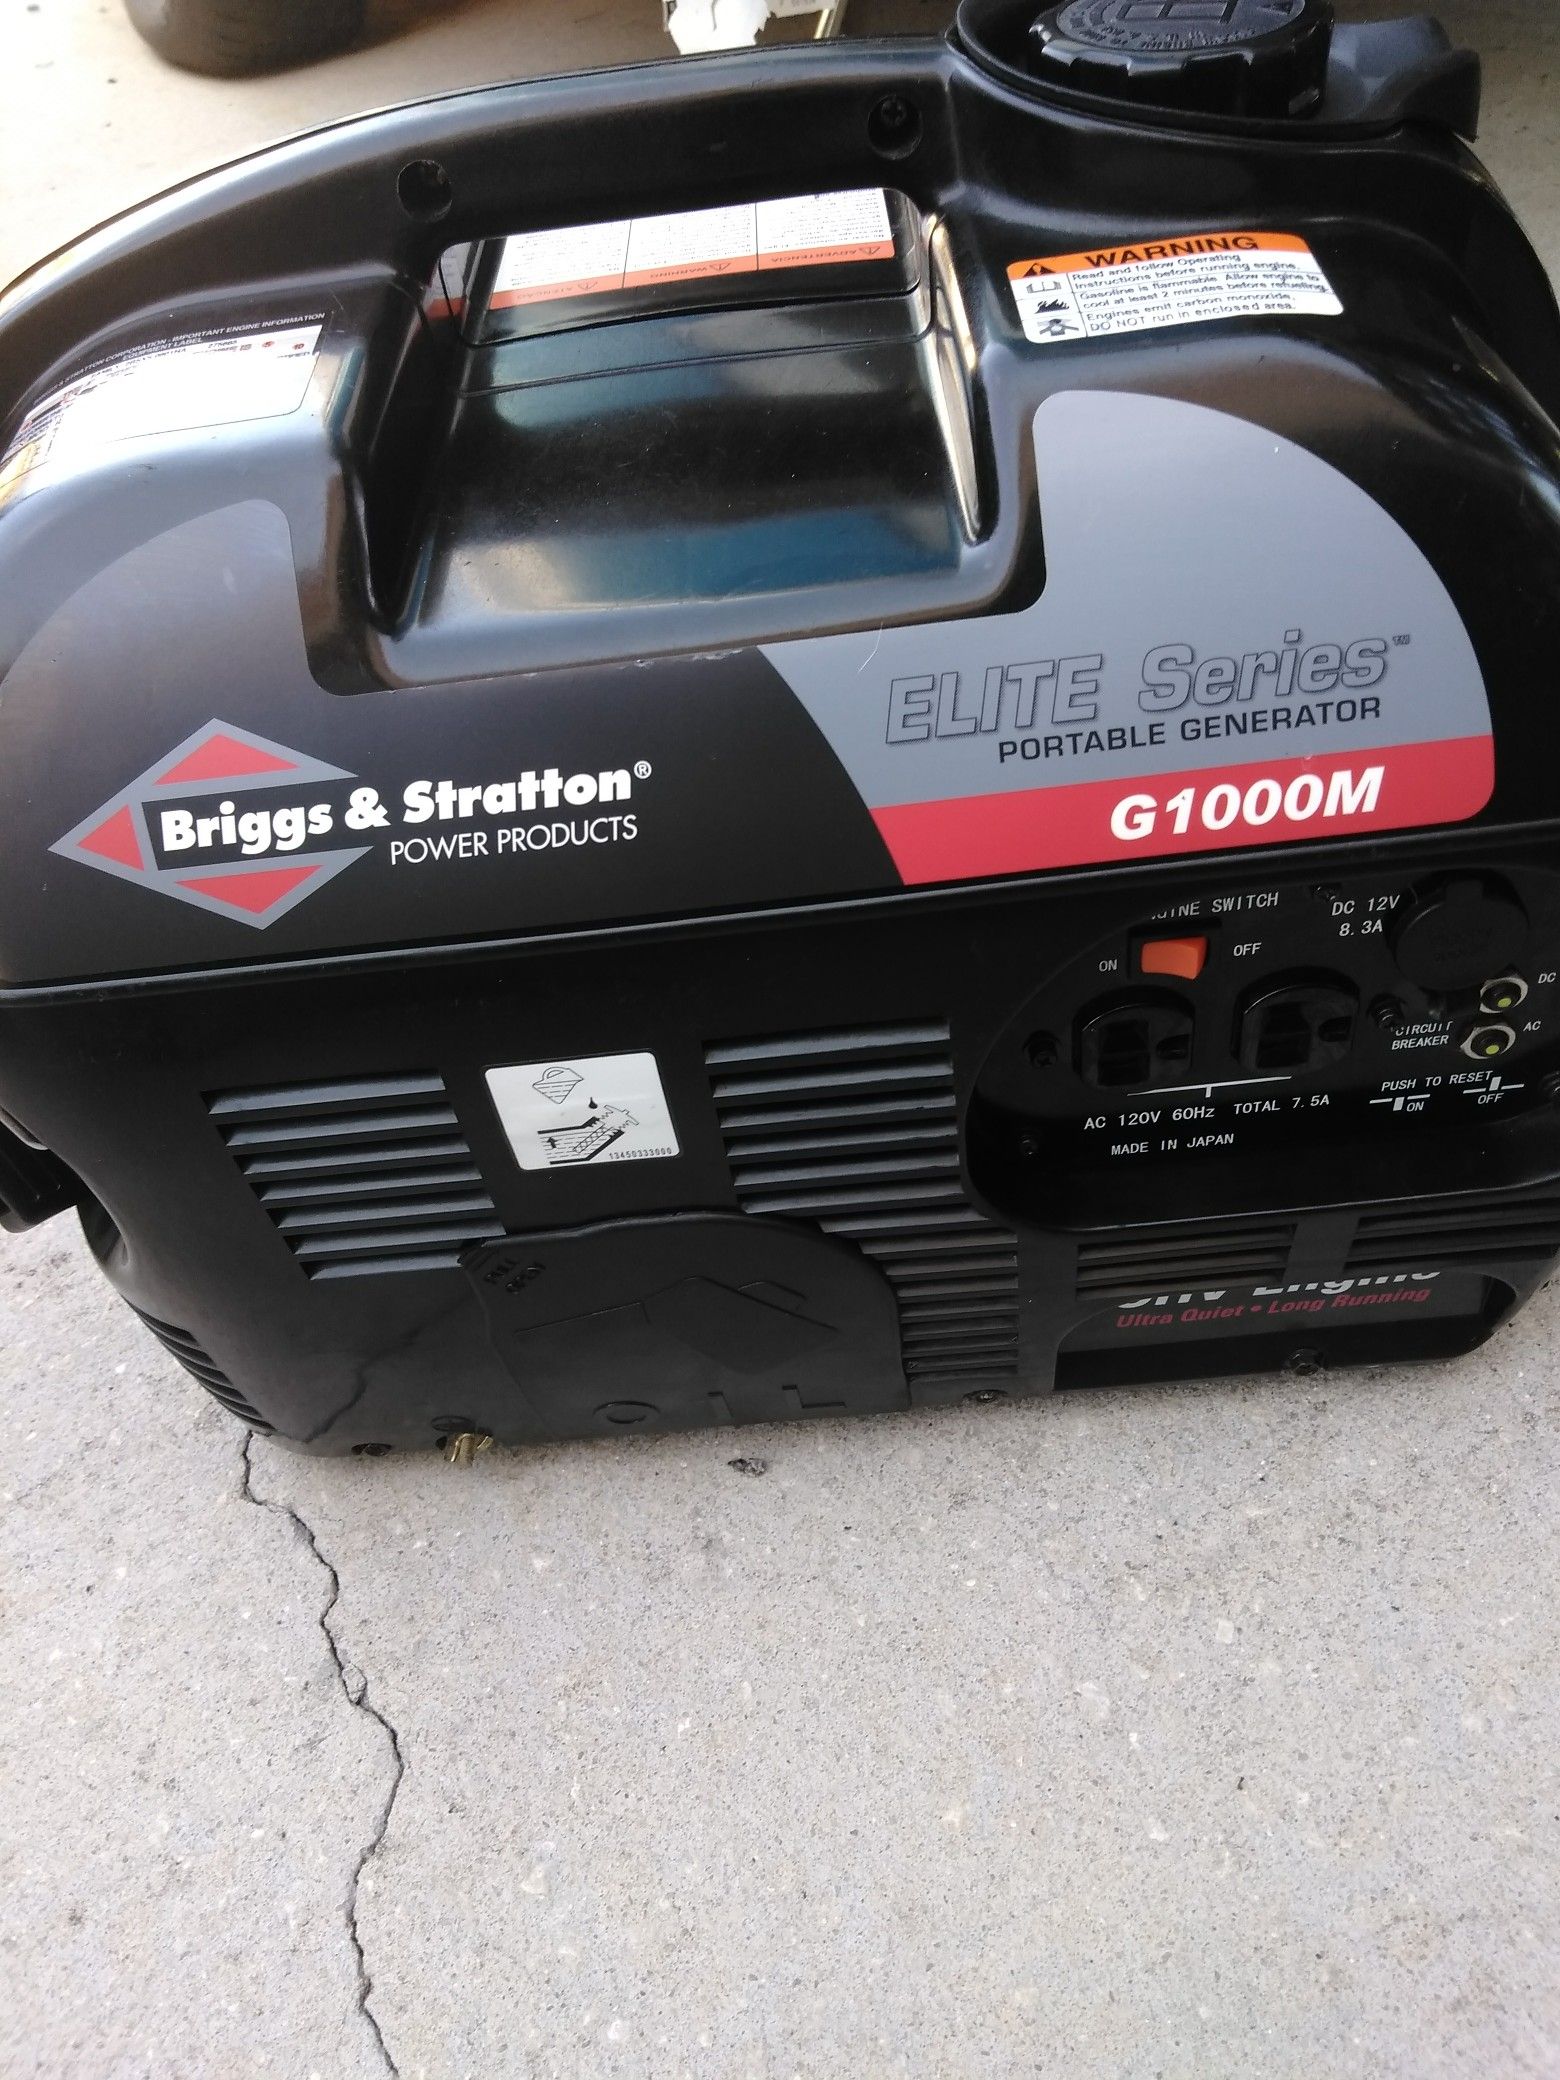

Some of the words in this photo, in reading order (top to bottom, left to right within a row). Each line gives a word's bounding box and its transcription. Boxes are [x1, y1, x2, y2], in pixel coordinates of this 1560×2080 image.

[1084, 236, 1259, 268] WARNING
[1072, 271, 1104, 281] Read
[1109, 266, 1131, 275] and
[1135, 261, 1174, 272] follow
[1177, 254, 1241, 267] Operating
[1074, 273, 1151, 290] Instructions
[1155, 267, 1196, 279] before
[1200, 261, 1250, 272] running
[1079, 288, 1134, 300] Gasoline
[1138, 285, 1149, 293] is
[1225, 273, 1258, 281] Allow
[1262, 272, 1304, 284] engine
[1306, 273, 1320, 282] to
[1083, 298, 1110, 309] cool
[1114, 296, 1125, 305] at
[1128, 292, 1159, 303] least
[1161, 290, 1169, 298] 2
[1173, 285, 1224, 298] minutes
[1227, 281, 1267, 290] before
[1086, 308, 1140, 321] Engines
[1144, 302, 1172, 312] emit
[1176, 297, 1222, 308] carbon
[1090, 321, 1111, 332] DO
[1116, 316, 1145, 328] NOT
[1152, 314, 1174, 323] run
[1178, 310, 1190, 319] in
[1194, 302, 1260, 316] enclosed
[105, 338, 167, 362] CORPORATION
[172, 327, 226, 342] IMPORTANT
[225, 322, 261, 333] ENGINE
[261, 312, 326, 328] INFORMATION
[122, 343, 172, 361] EQUIPMENT
[173, 337, 203, 347] LABEL
[885, 653, 1104, 745] ELITE
[998, 722, 1166, 764] PORTABLE
[1180, 696, 1382, 742] GENERATOR
[1109, 765, 1386, 843] G1000M
[159, 800, 334, 856] Briggs
[344, 785, 392, 831] &
[390, 830, 489, 867] POWER
[497, 813, 639, 855] PRODUCTS
[1151, 900, 1200, 920] INE
[1211, 891, 1280, 914] SWITCH
[1331, 900, 1356, 917] DC
[1366, 895, 1401, 913] 12V
[1233, 941, 1262, 957] OFF
[1098, 959, 1118, 973] ON
[1538, 972, 1557, 985] DC
[1522, 1020, 1542, 1033] AC
[1391, 1034, 1449, 1051] BREAKER
[1381, 1078, 1417, 1092] PUSH
[1425, 1075, 1442, 1088] TO
[1449, 1070, 1493, 1085] RESET
[1084, 1115, 1107, 1130] AC
[1119, 1108, 1161, 1127] 120V
[1172, 1105, 1216, 1122] 60Hz
[1233, 1099, 1281, 1115] TOTAL
[1291, 1093, 1331, 1109] 7.5A
[1406, 1100, 1425, 1112] ON
[1477, 1092, 1505, 1105] OFF
[1111, 1140, 1149, 1157] MADE
[1161, 1136, 1178, 1152] IN
[1186, 1132, 1235, 1149] JAPAN
[1116, 1312, 1173, 1328] Ultra
[1180, 1303, 1246, 1323] Quiet
[1267, 1299, 1326, 1314] Long
[1331, 1288, 1433, 1308] Running
